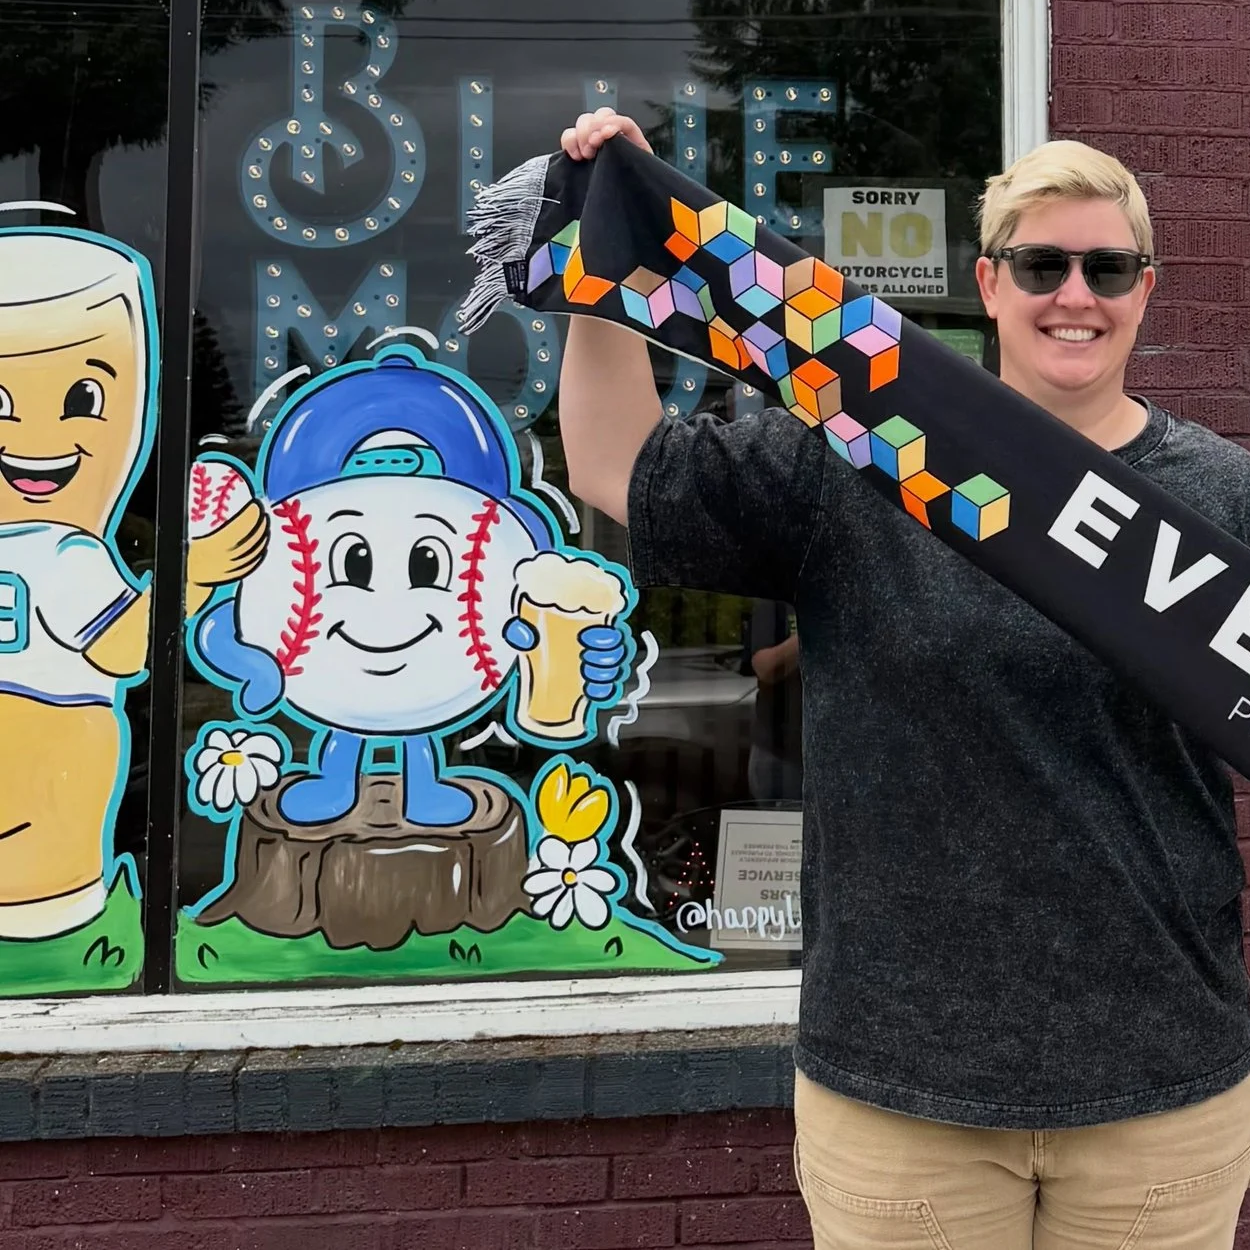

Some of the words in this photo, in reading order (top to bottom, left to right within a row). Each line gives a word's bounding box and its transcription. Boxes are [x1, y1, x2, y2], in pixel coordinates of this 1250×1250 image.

[852, 191, 921, 205] SORRY
[841, 211, 933, 258] NO
[882, 284, 944, 294] ALLOWED
[738, 869, 801, 882] SERVICE
